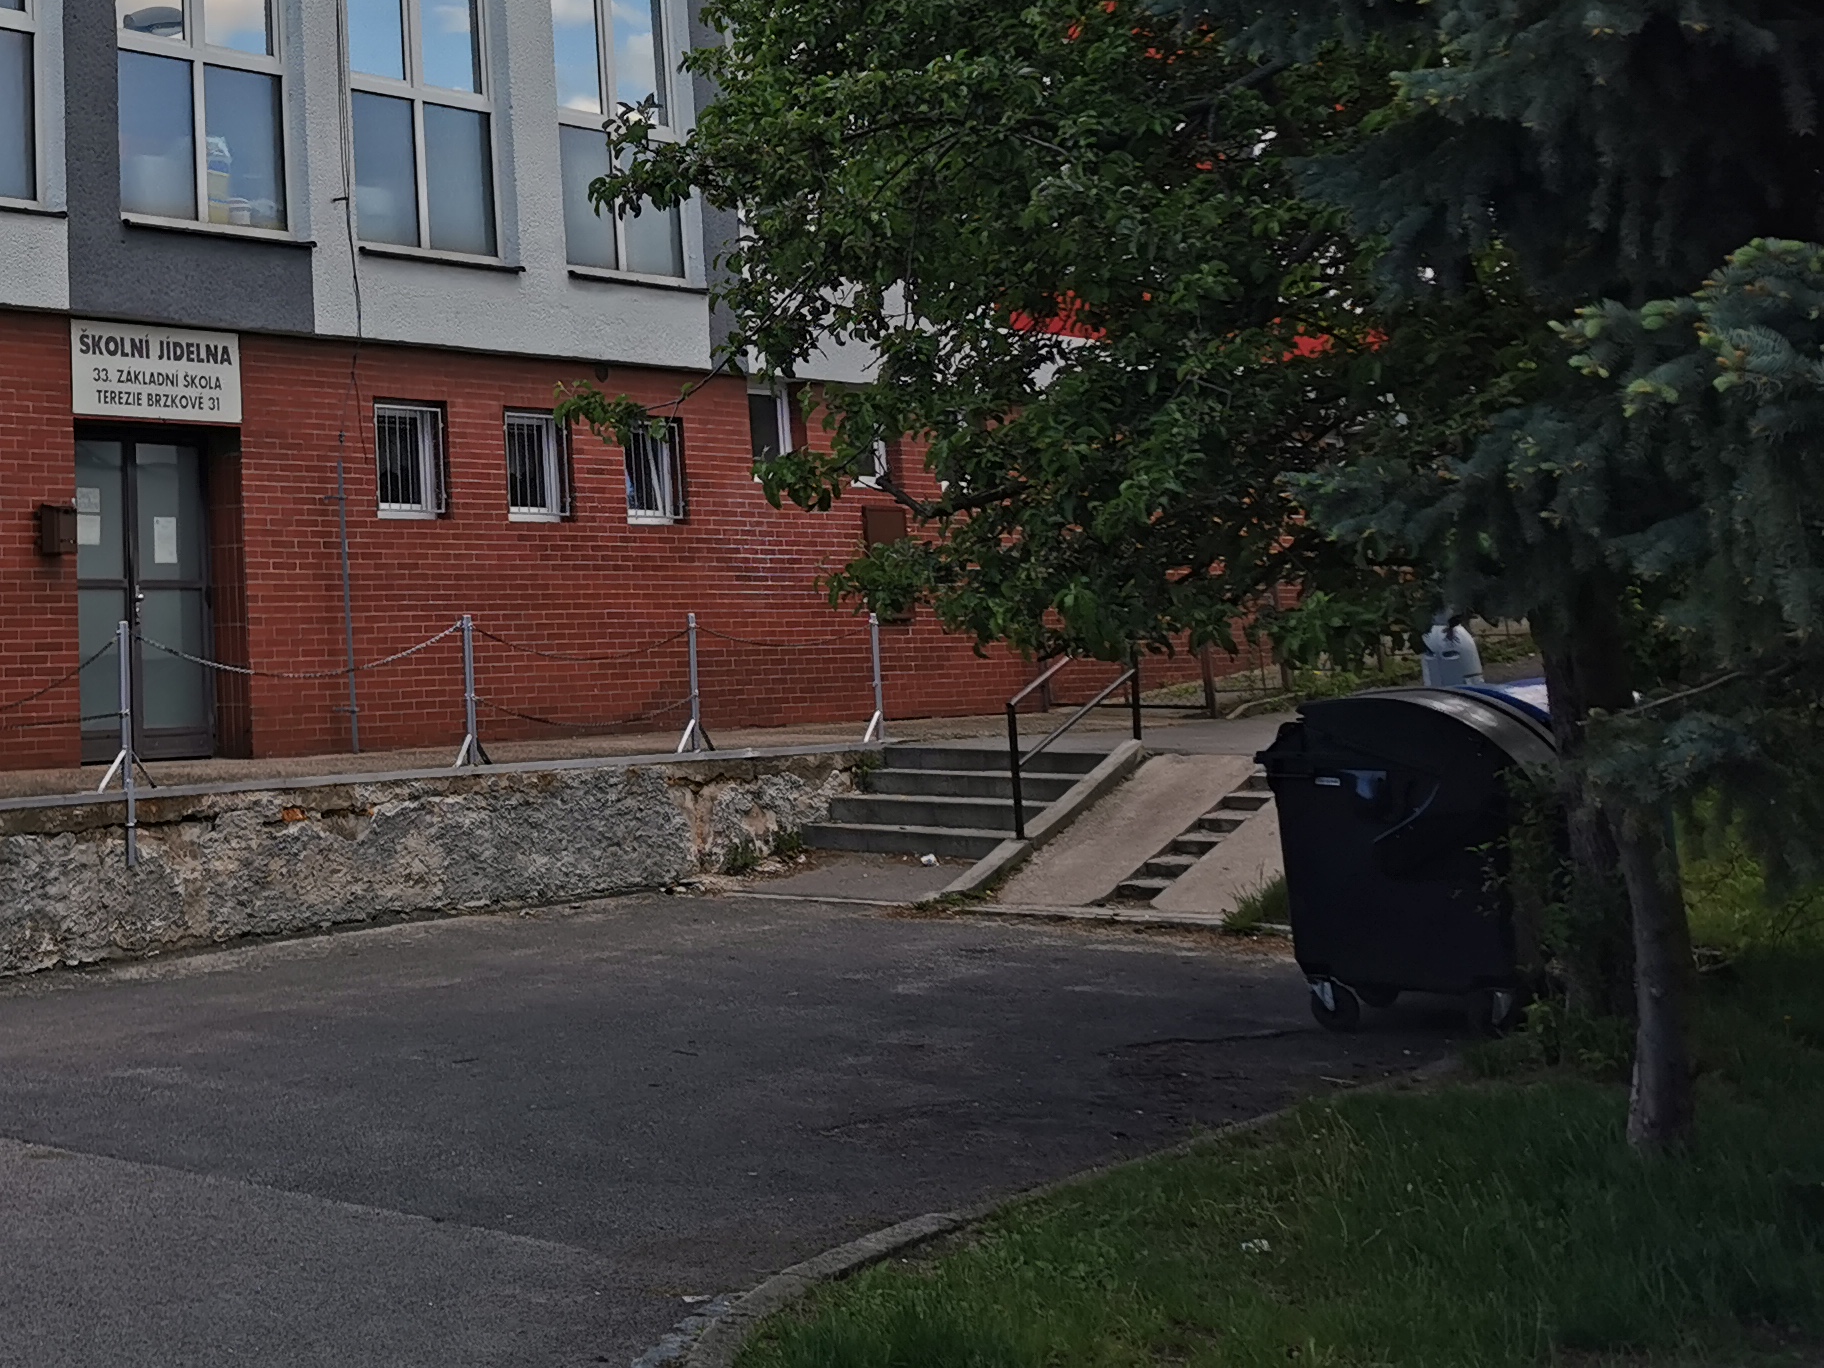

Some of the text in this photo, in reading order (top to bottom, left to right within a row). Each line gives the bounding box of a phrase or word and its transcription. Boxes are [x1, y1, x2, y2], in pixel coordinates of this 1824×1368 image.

[79, 328, 232, 365] ŠKOLNÍ JÍDELNA
[93, 366, 222, 391] 33. ZÁKLADNÍ ŠKOLA
[96, 390, 220, 411] TEREZIE BRZKOVÉ 31
